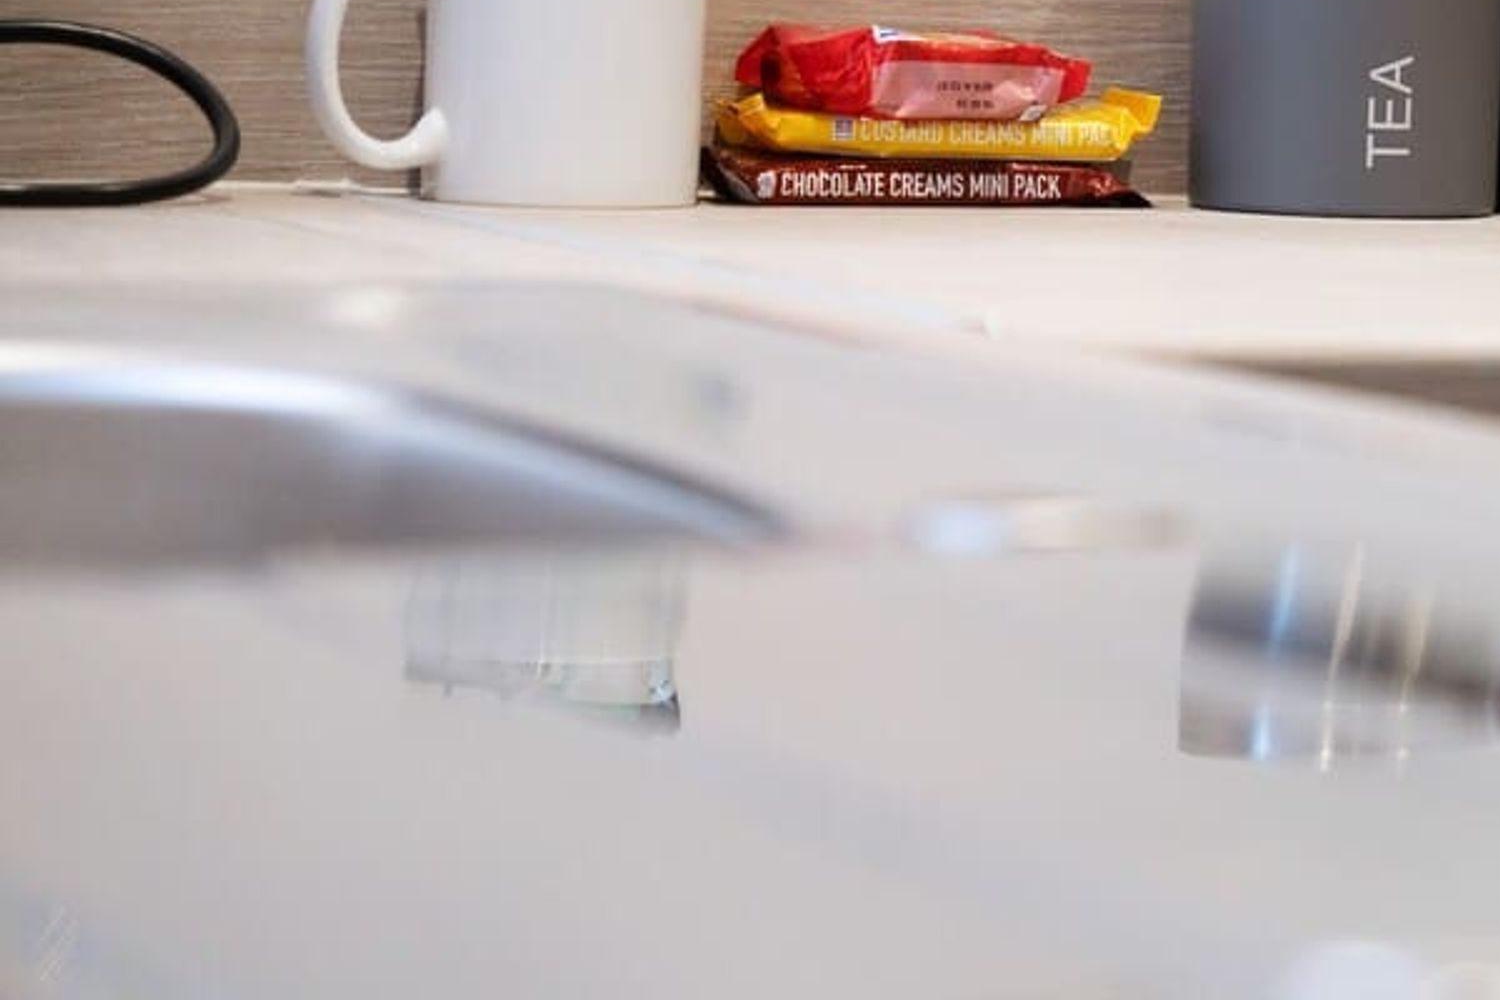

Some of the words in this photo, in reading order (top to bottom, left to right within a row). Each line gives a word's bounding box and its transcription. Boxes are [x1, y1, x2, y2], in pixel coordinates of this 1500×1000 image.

[1365, 55, 1416, 170] TEA
[860, 118, 943, 143] CUSTARD
[950, 119, 1026, 145] CREAMS
[781, 171, 885, 197] CHOCOLATE
[889, 172, 965, 197] CREAMS
[969, 173, 1009, 198] MINI
[1013, 174, 1061, 199] PACK
